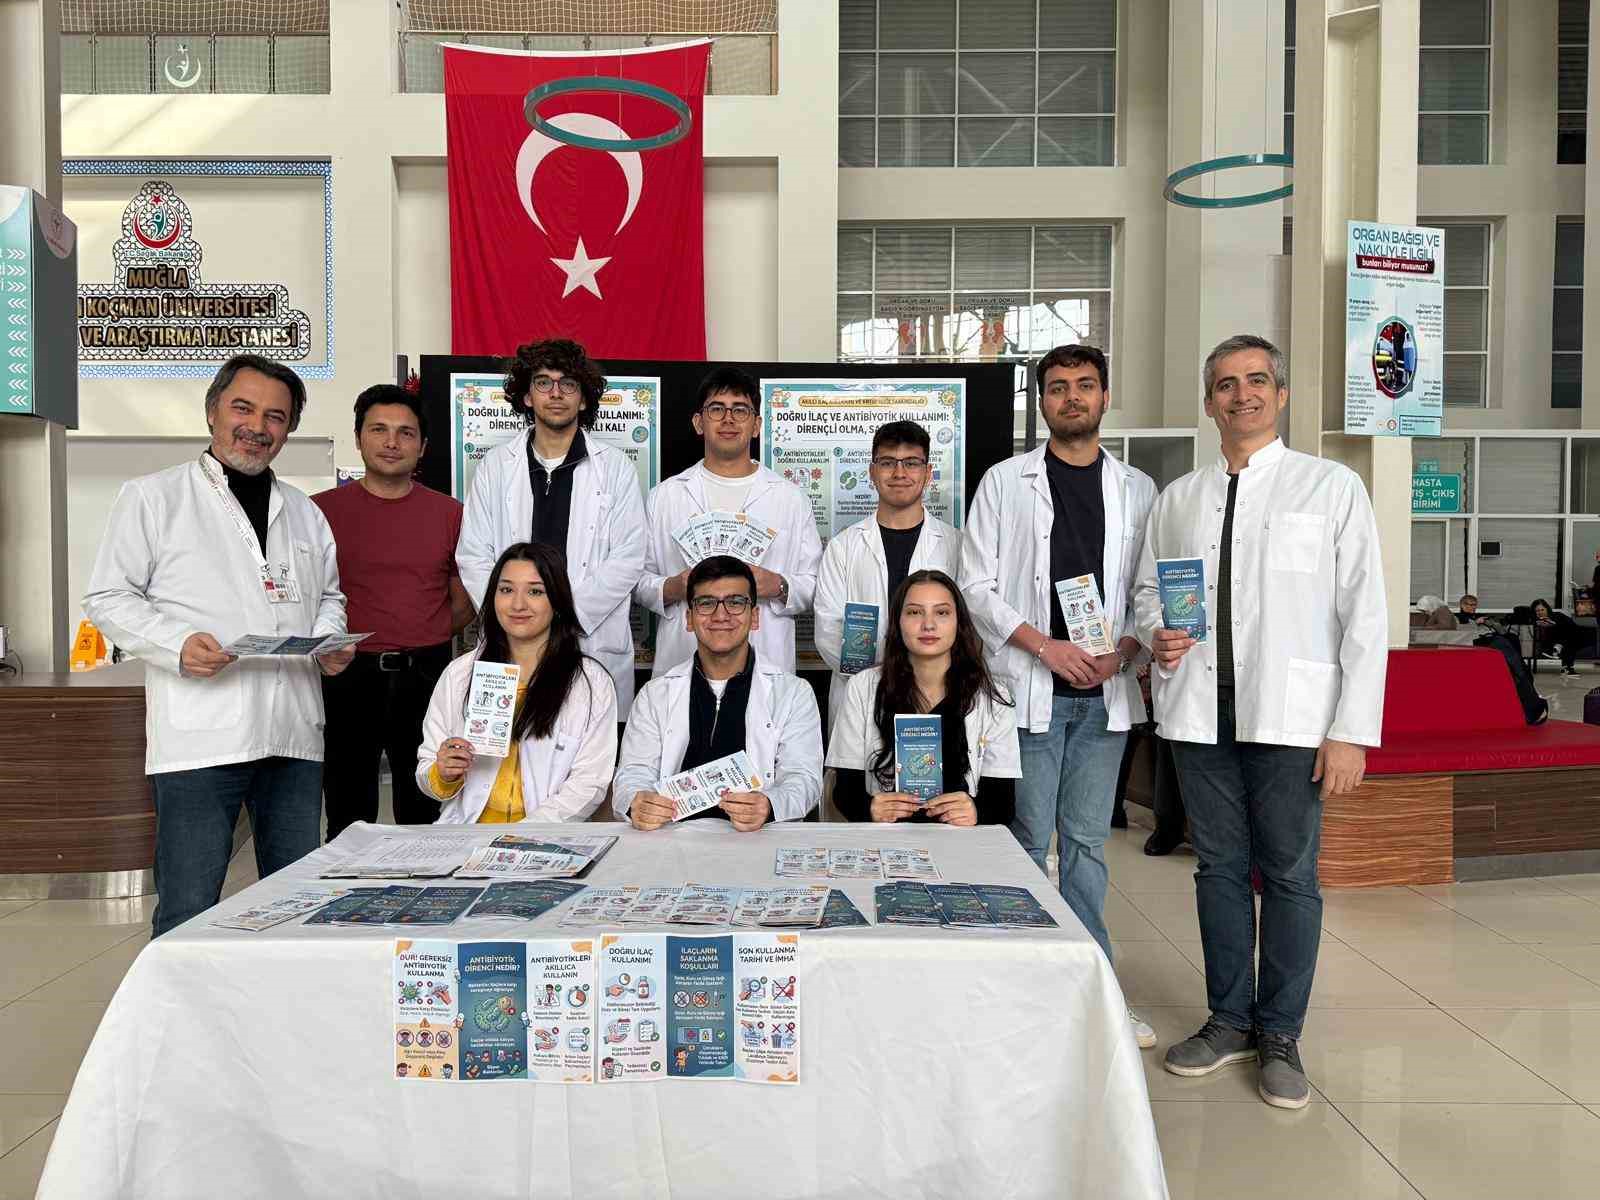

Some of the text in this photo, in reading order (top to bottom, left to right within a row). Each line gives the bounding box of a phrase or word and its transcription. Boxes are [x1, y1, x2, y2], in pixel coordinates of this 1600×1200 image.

[1353, 227, 1391, 243] ORGAN
[1426, 234, 1440, 247] VE
[127, 263, 190, 289] MUĞLA
[85, 296, 159, 321] KOÇMAN
[161, 292, 276, 318] ÜNİVERSİTESİ
[79, 322, 299, 352] VE ARAŞTIRMA HASTANESİ
[468, 406, 500, 417] DOĞRU
[777, 410, 949, 424] DOĞRU İLAÇ VE ANTİBİYOTİK KULLANIMI:
[605, 422, 626, 432] KAL!
[797, 422, 837, 435] DİRENÇLİ
[838, 425, 867, 435] OLMA,
[1413, 478, 1441, 487] HASTA
[1413, 498, 1440, 508] BİRİMİ
[609, 946, 653, 957] DOĞRU İLAÇ
[680, 946, 717, 957] İLAÇLARIN
[755, 946, 796, 955] KULLANMA
[419, 954, 452, 963] GEREKSİZ
[469, 955, 516, 964] ANTİBİYOTİK
[611, 956, 652, 964] KULLANIMI
[740, 954, 794, 963] TARİHİ VE İMHA
[403, 961, 447, 970] ANTİBİYOTİK
[496, 963, 520, 972] NEDİR?
[680, 962, 719, 972] KOŞULLARI
